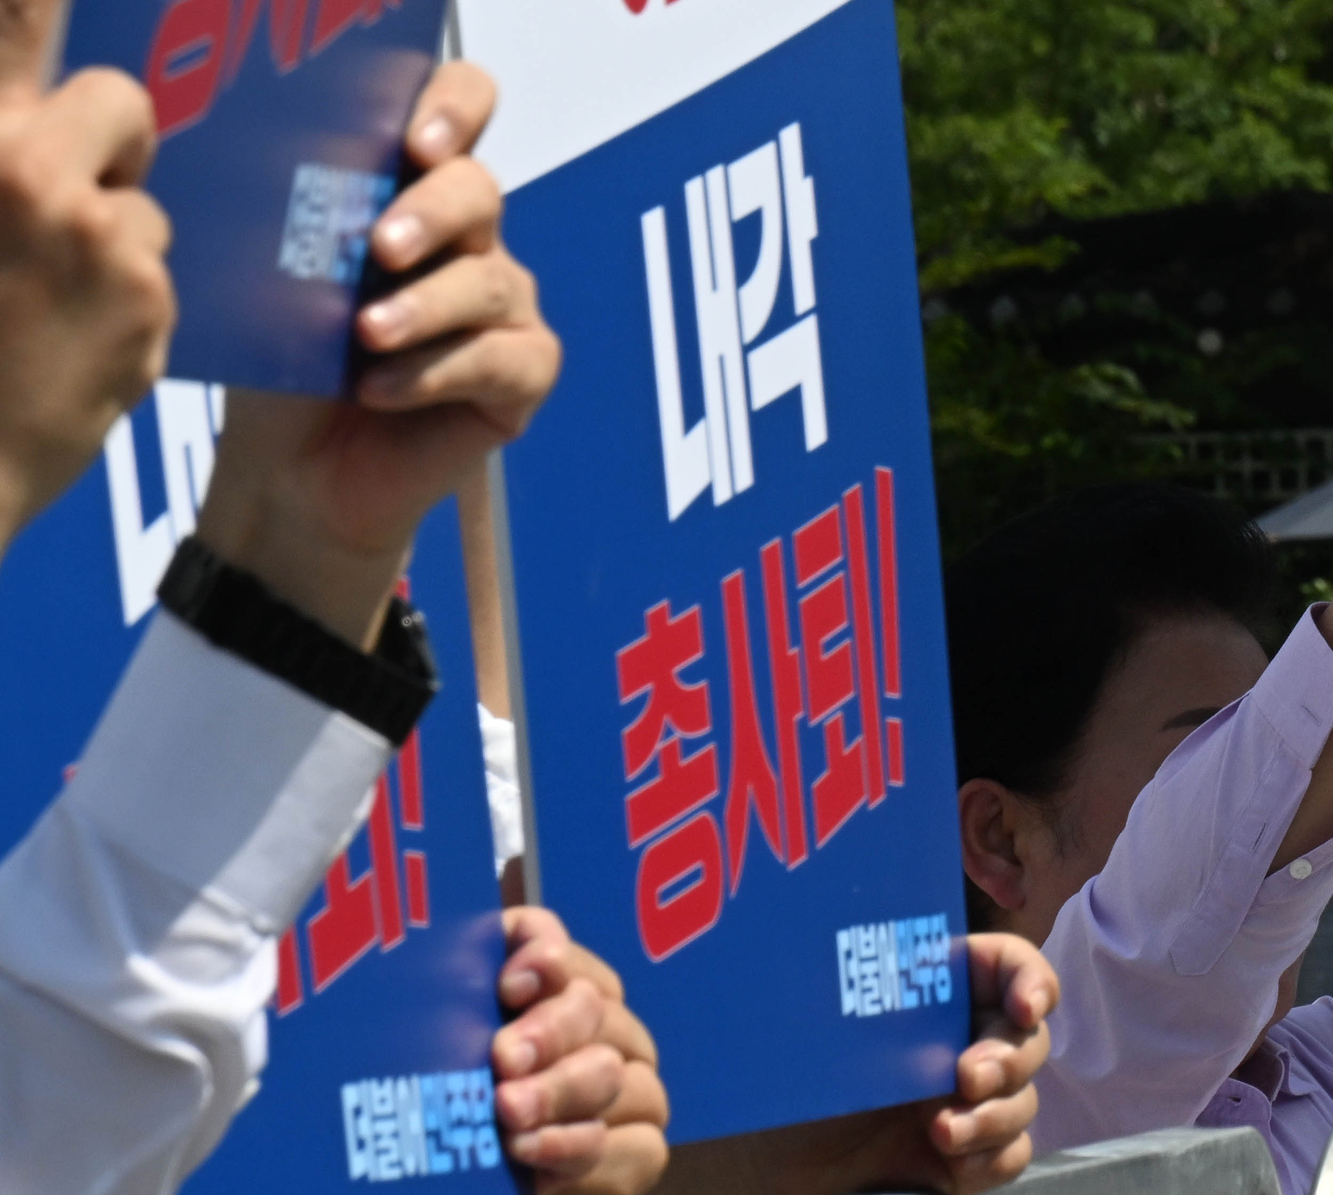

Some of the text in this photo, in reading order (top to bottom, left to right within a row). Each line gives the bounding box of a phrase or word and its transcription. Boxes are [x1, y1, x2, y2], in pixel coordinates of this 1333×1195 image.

[641, 121, 828, 521] 내각
[615, 465, 905, 962] 총사퇴!
[836, 913, 953, 1018] 더불어민주당
